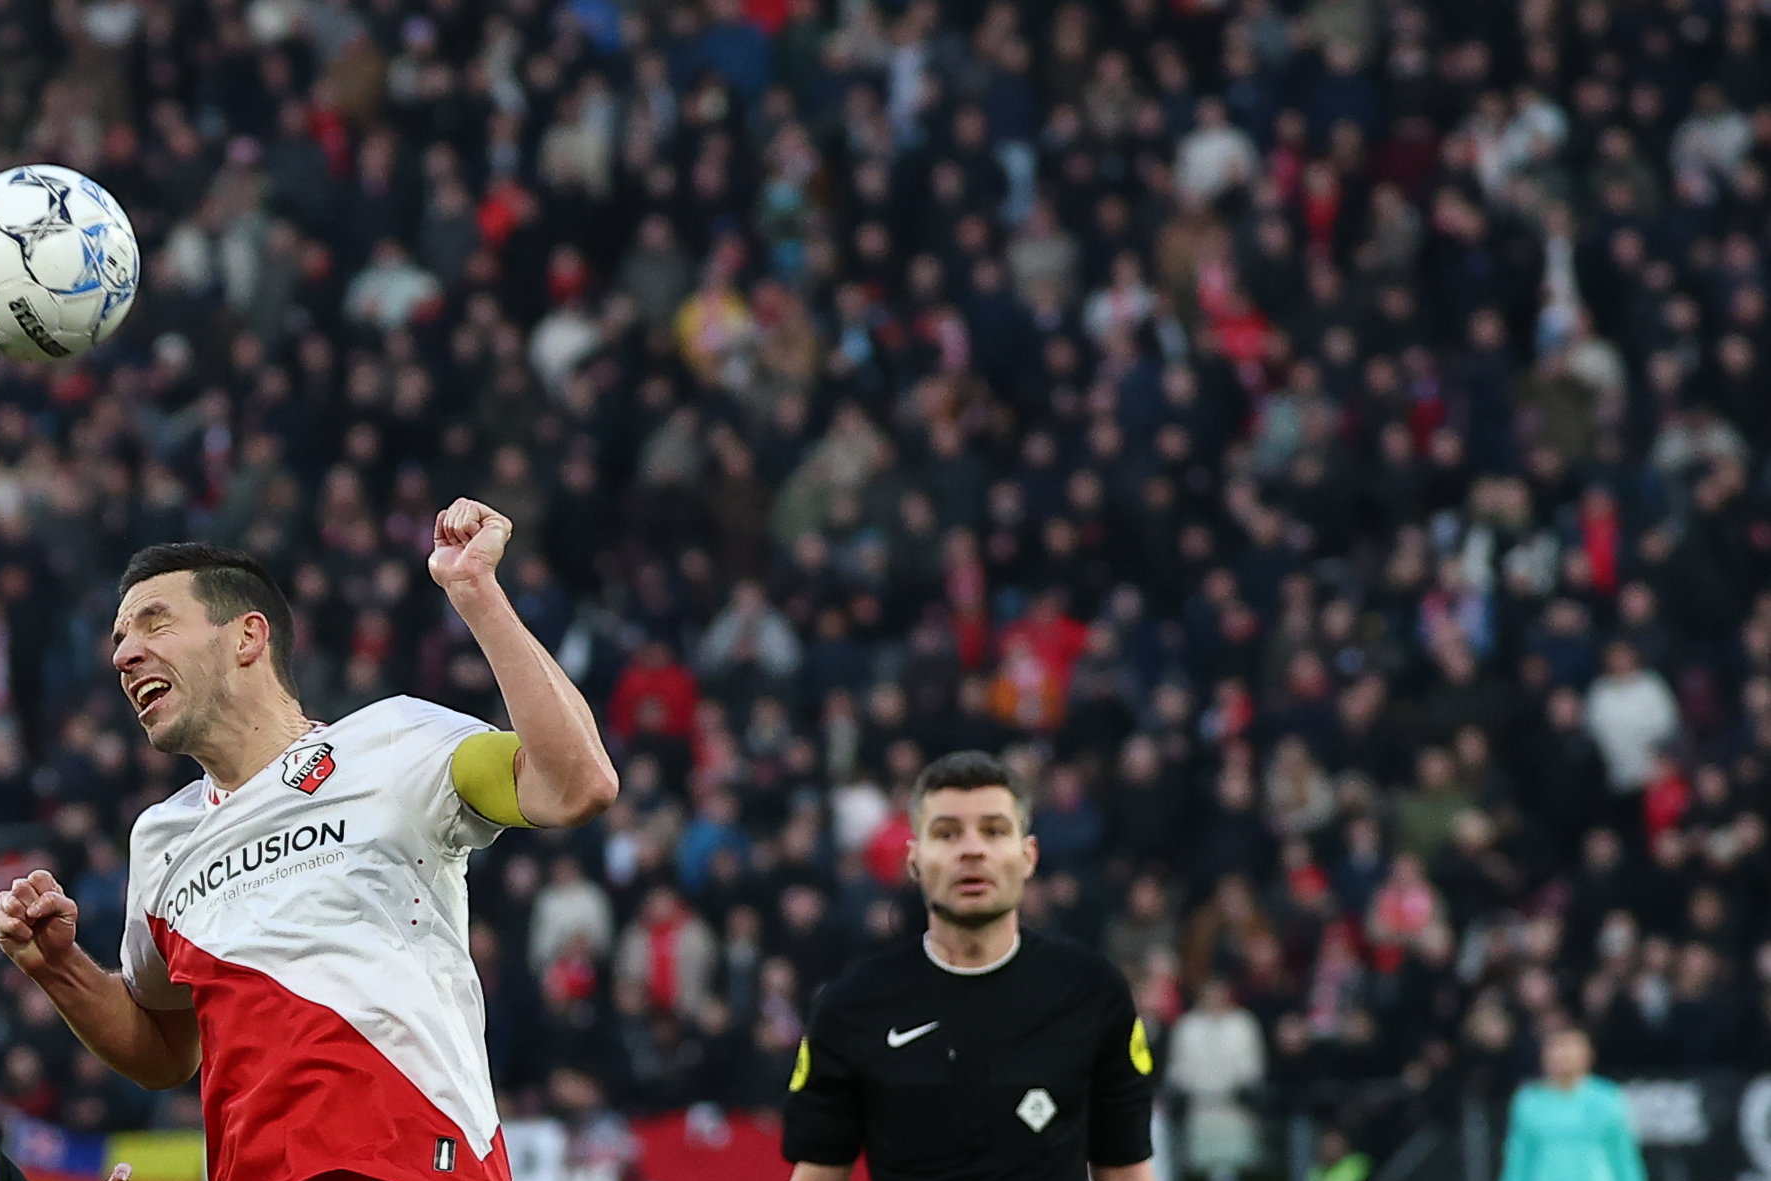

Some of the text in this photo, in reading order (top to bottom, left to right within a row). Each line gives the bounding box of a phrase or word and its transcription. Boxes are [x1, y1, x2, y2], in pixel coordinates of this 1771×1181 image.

[289, 745, 330, 788] UTRECHT
[312, 766, 326, 780] C
[166, 819, 346, 931] CONCLUSION
[242, 850, 346, 893] transformation
